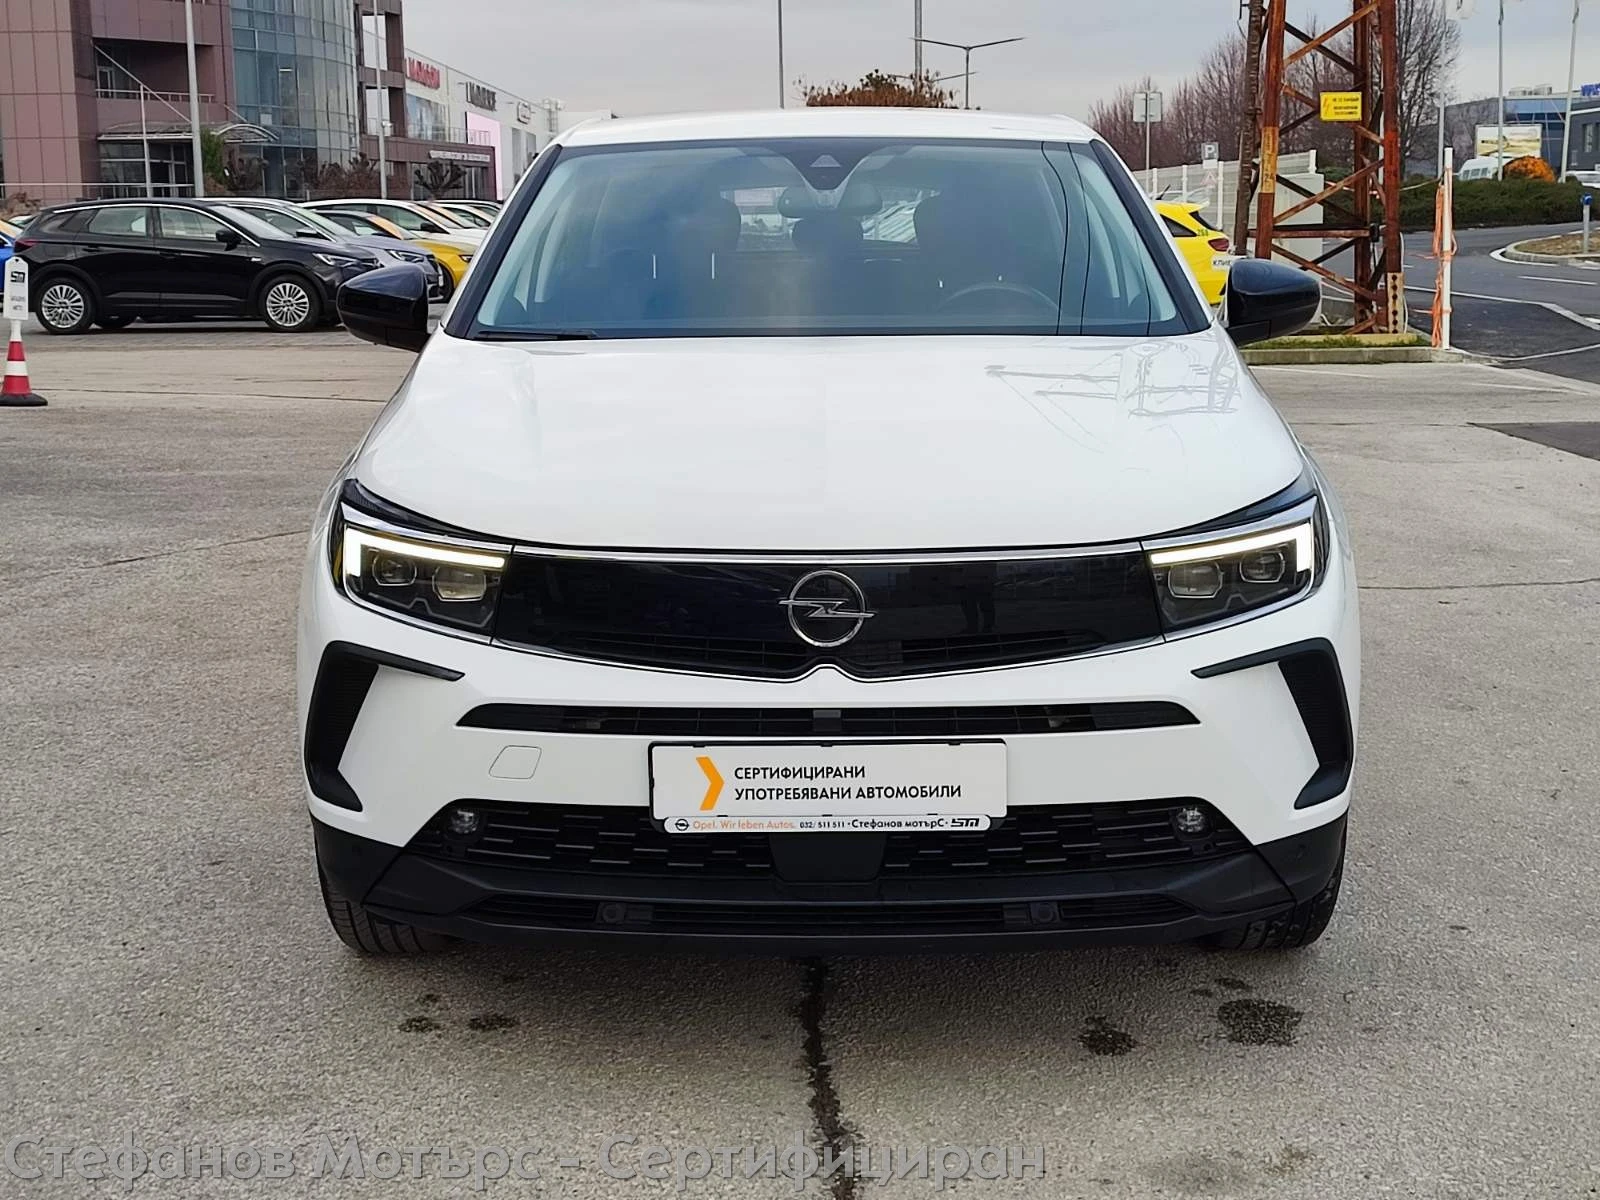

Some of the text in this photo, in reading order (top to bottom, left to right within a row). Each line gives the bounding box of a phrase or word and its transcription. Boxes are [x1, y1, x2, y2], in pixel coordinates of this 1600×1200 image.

[1204, 144, 1216, 158] P
[734, 766, 865, 780] СЕРТИФИЦИРАНИ
[735, 785, 962, 800] УПОТРЕБЯВАНИ АВТОМОБИЛИ
[693, 820, 718, 831] Opel.
[720, 820, 735, 829] Wir
[738, 819, 764, 829] leben
[818, 820, 830, 828] 511
[833, 820, 845, 828] 511
[851, 818, 902, 830] Стефанов
